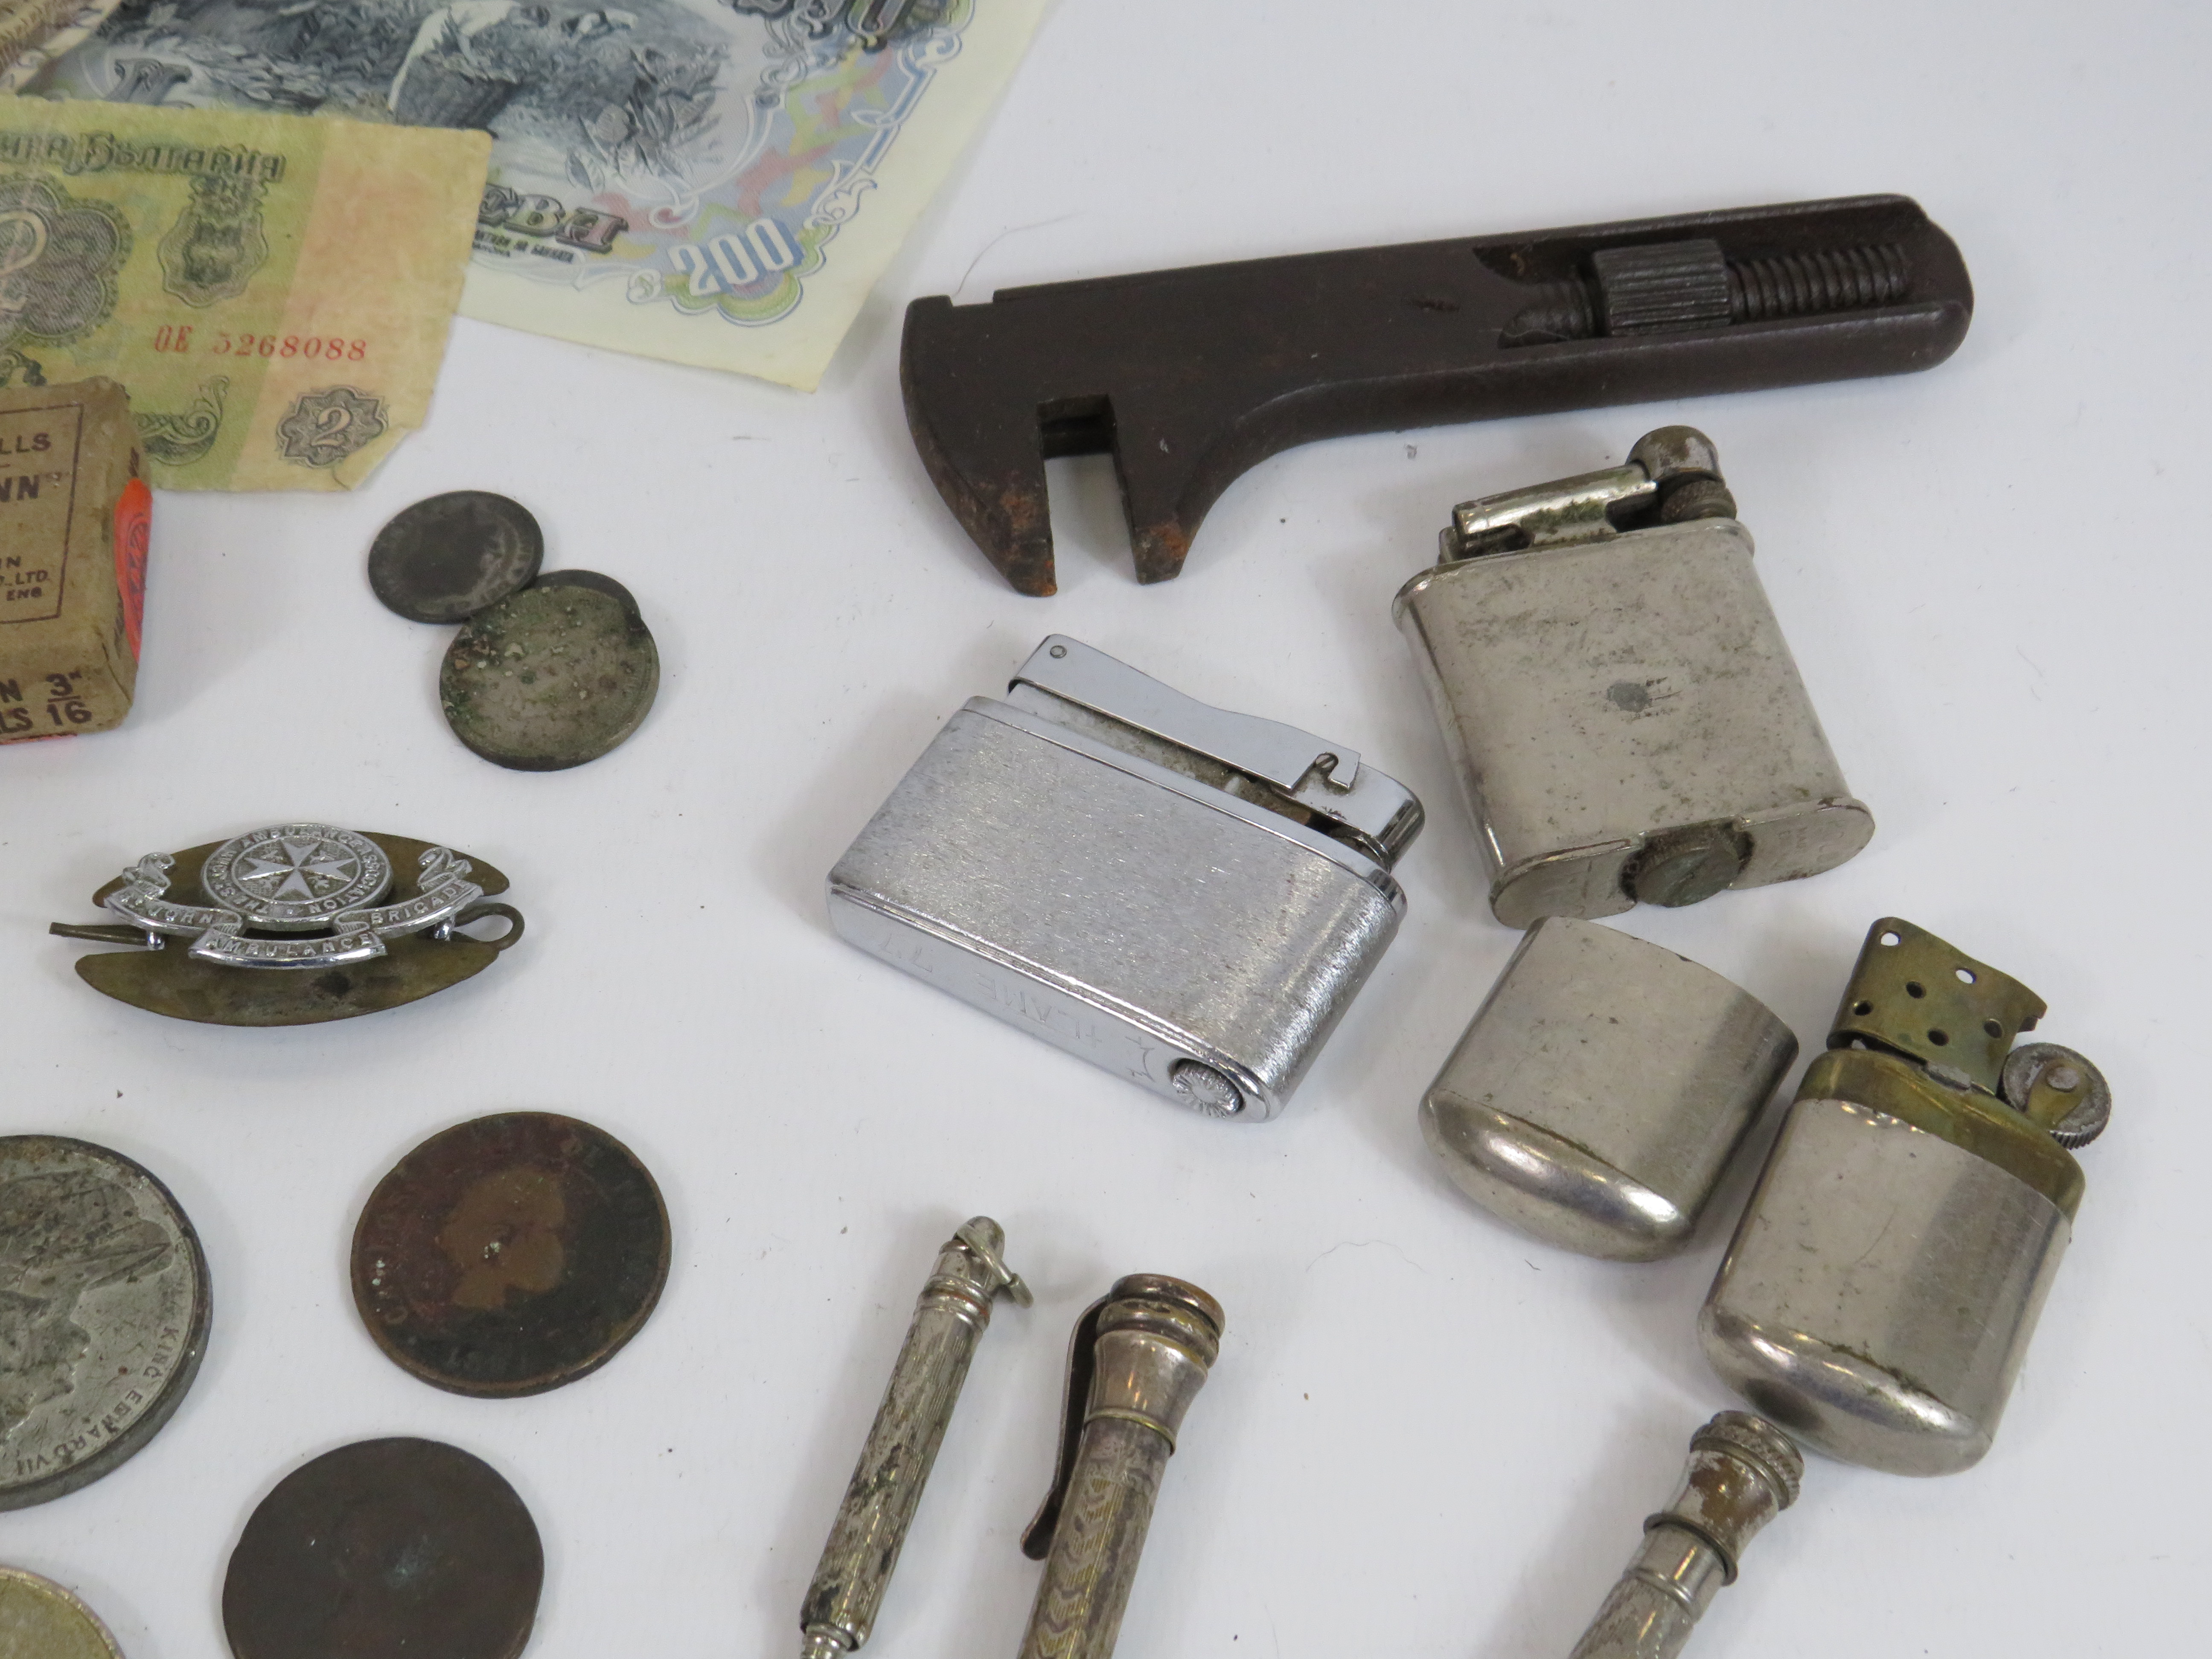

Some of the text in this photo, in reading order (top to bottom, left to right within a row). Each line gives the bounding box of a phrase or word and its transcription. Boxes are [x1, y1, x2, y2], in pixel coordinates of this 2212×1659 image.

[667, 218, 800, 297] 200
[311, 406, 353, 447] 2
[148, 905, 212, 925] JOHN
[206, 933, 373, 958] AMBULANCE
[143, 1325, 179, 1379] KING
